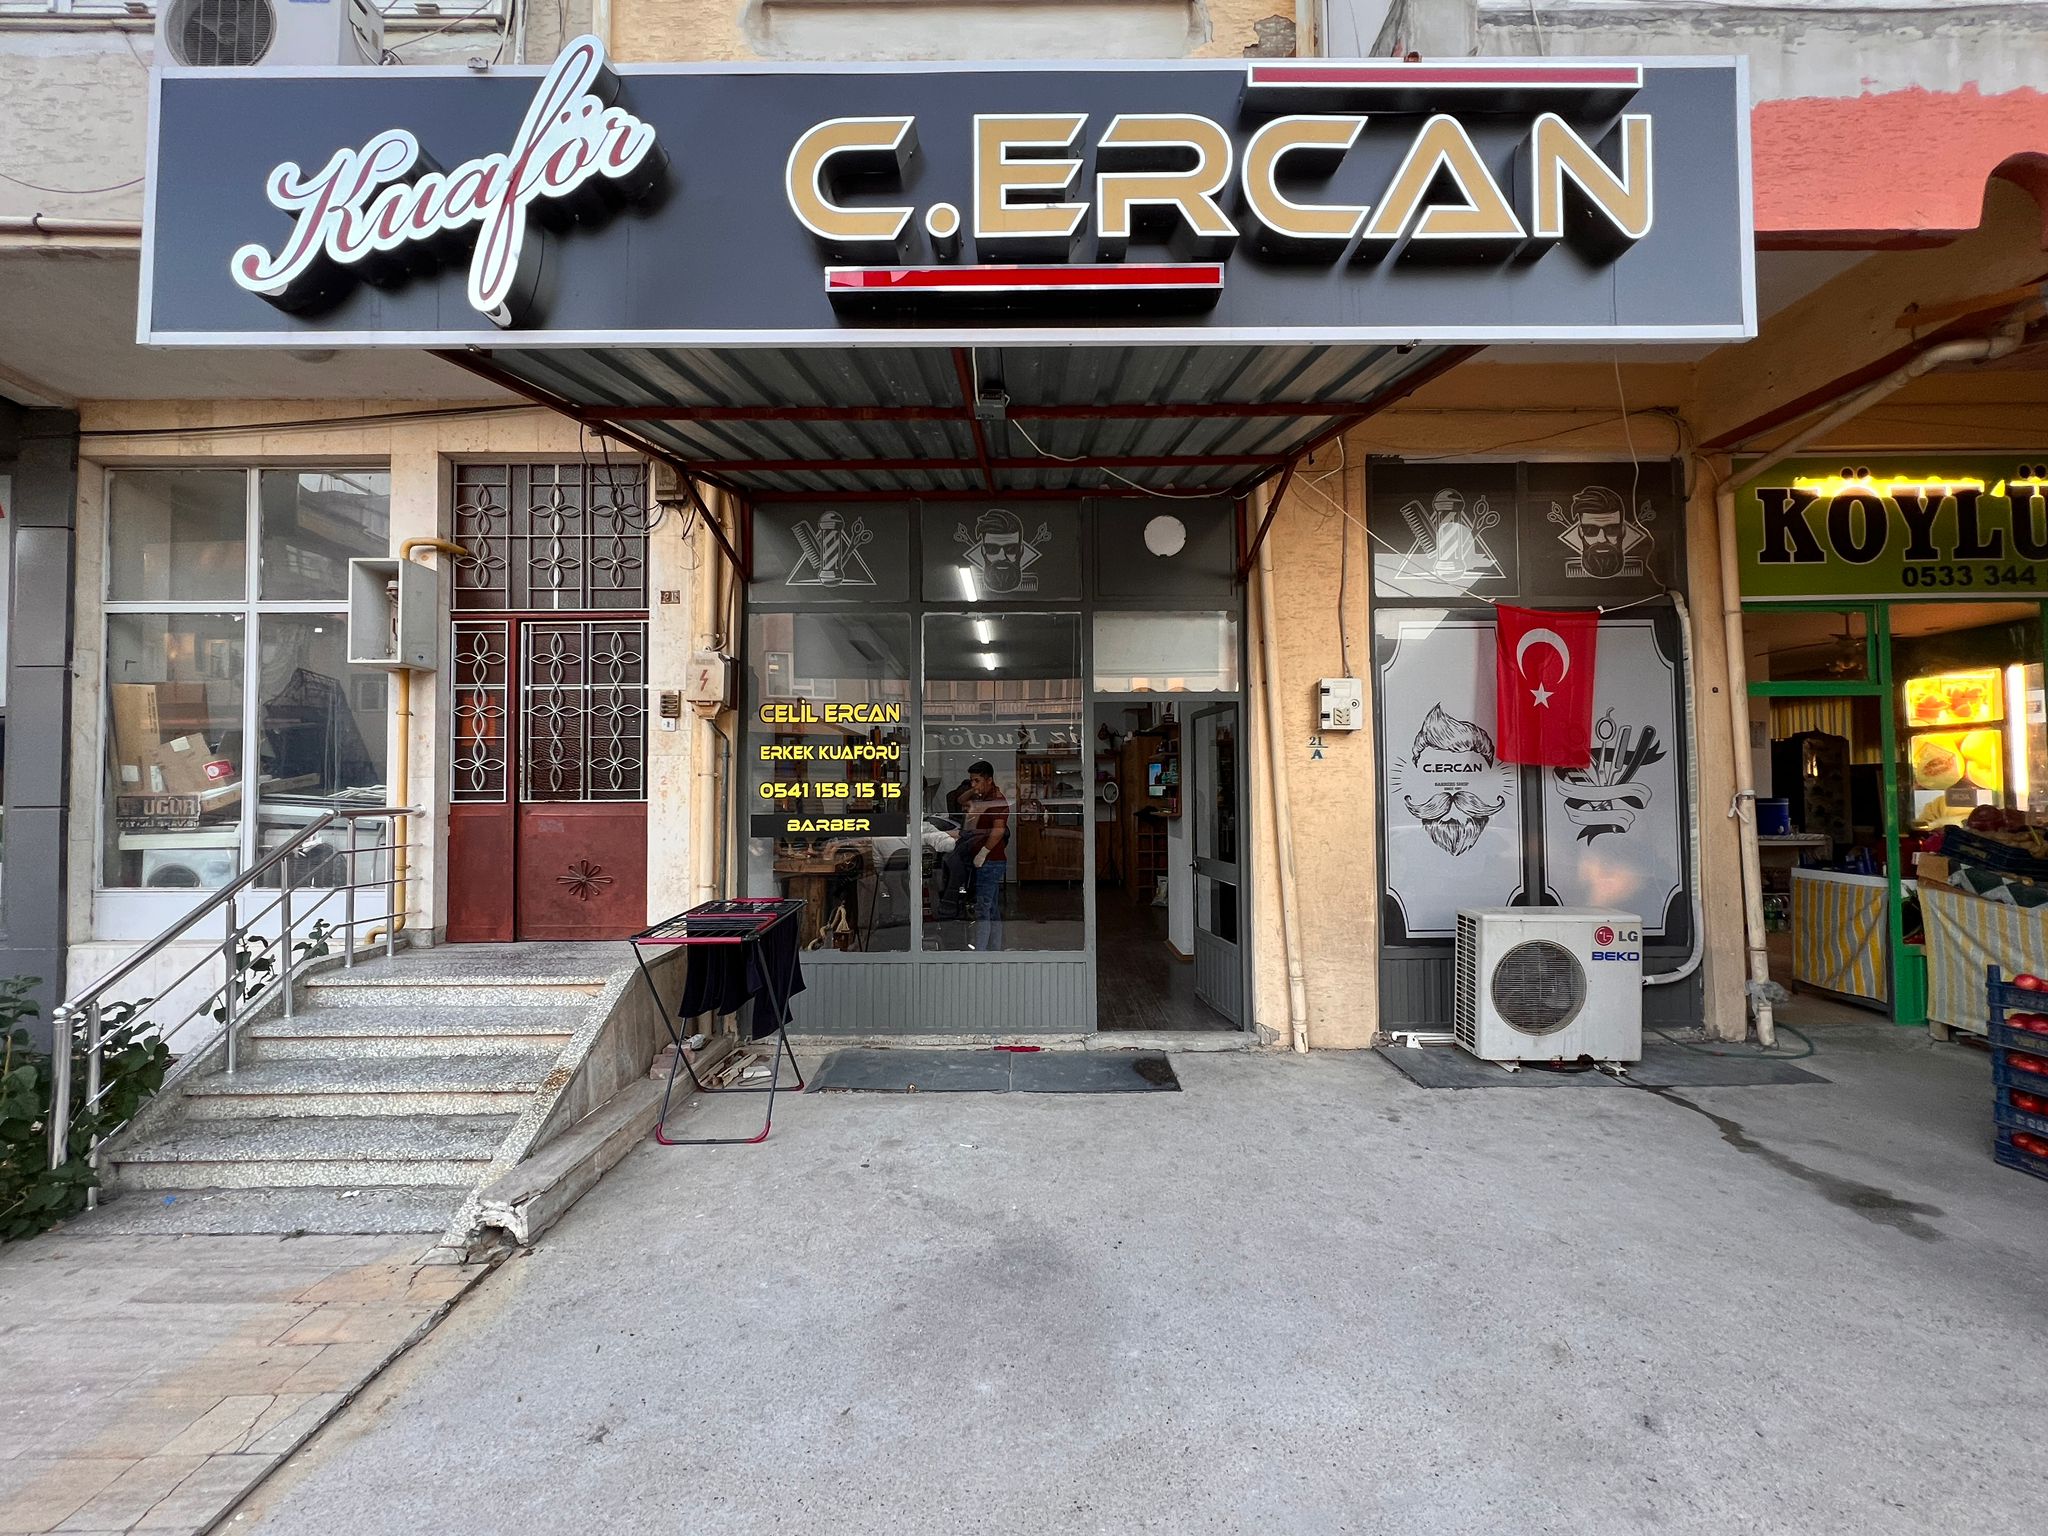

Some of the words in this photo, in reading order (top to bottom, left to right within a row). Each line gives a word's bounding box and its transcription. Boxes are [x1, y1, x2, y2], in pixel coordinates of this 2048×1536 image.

[231, 34, 656, 312] Kuaför
[786, 111, 1653, 241] C.ERCAN
[1755, 465, 2048, 565] KÖYLÜ
[1902, 566, 1973, 587] 0533
[1985, 565, 2037, 586] 344
[760, 699, 818, 723] CELİL
[825, 703, 900, 723] ERCAN
[1309, 736, 1323, 746] 21
[760, 745, 814, 760] ERKEK
[819, 741, 899, 760] KUAFÖRÜ
[1311, 749, 1323, 759] A
[1423, 763, 1482, 773] C.ERCAN
[759, 782, 809, 798] 0541
[815, 782, 849, 798] 158
[855, 782, 875, 798] 15
[881, 782, 901, 798] 15
[787, 819, 870, 832] BARBER
[1618, 931, 1639, 942] LG
[1592, 952, 1639, 961] BEKO
